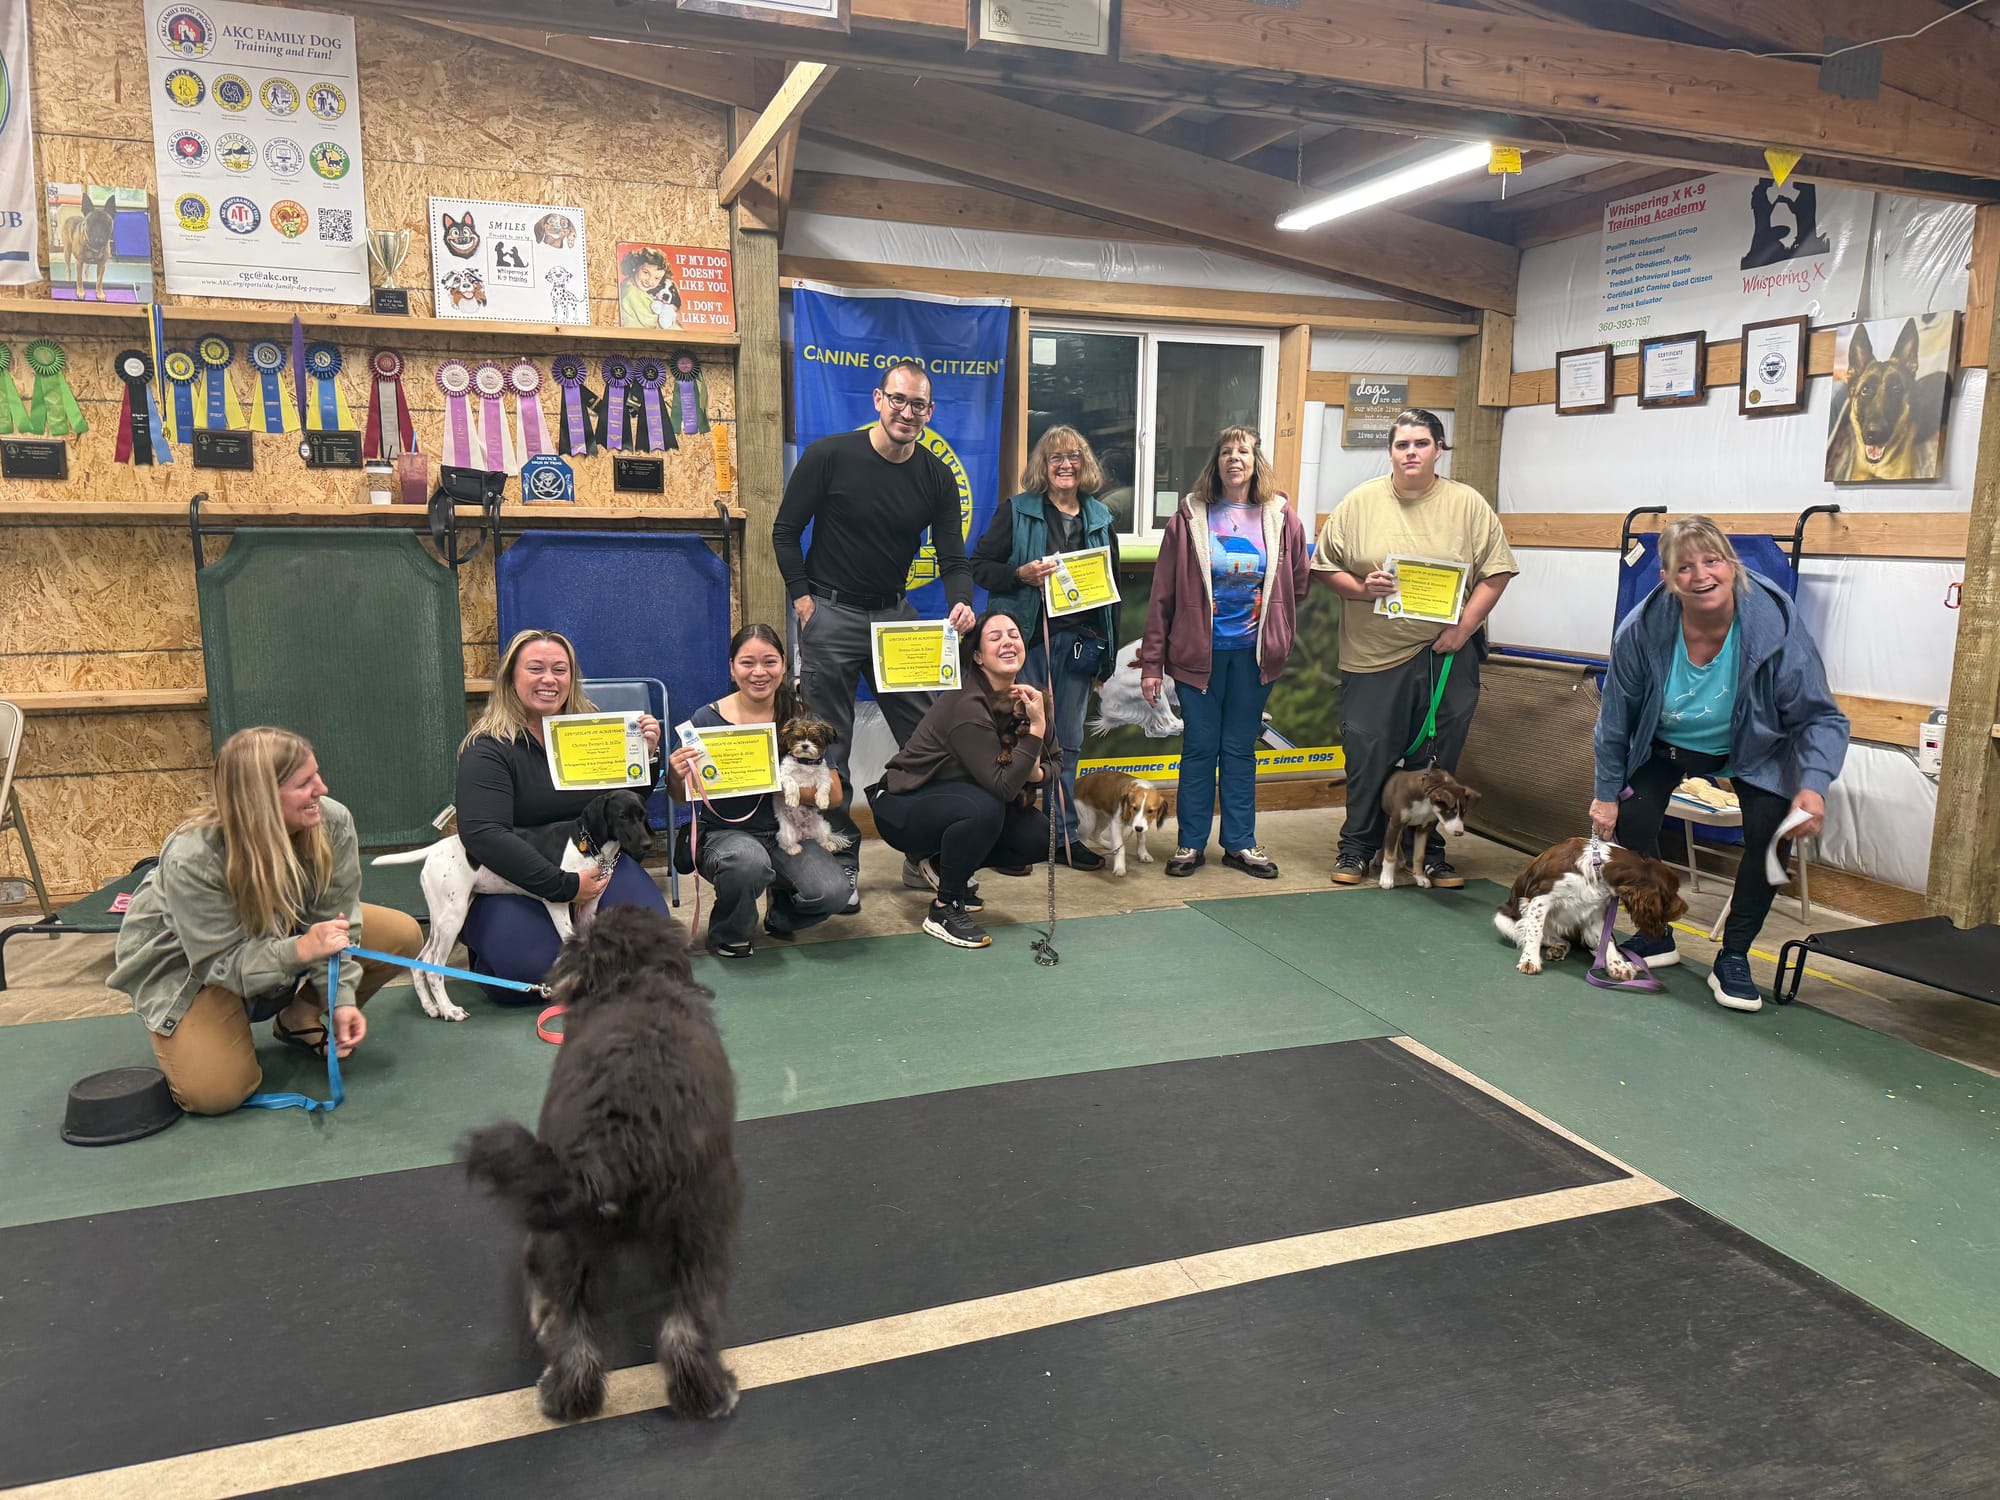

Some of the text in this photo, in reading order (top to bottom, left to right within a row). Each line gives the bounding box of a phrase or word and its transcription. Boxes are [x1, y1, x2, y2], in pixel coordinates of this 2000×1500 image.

[223, 24, 342, 49] AKC FAMILY DOG
[234, 39, 332, 60] Training and Fun!
[333, 145, 348, 160] DOG
[1609, 183, 1705, 218] Whispering X K-9
[231, 205, 249, 222] ATT
[1608, 200, 1706, 232] Training Academy
[488, 221, 527, 231] SMILES
[1628, 231, 1677, 247] Reinforcement
[1678, 226, 1698, 237] Group
[675, 254, 727, 267] IF MY DOG
[1605, 256, 1617, 264] and
[1673, 253, 1692, 263] Rally,
[239, 271, 299, 284] cgc@akc.org
[682, 267, 723, 279] DOESN'T
[1635, 271, 1670, 283] Behavioral
[1671, 267, 1691, 276] Issues
[1742, 262, 1826, 296] Whispering X
[679, 280, 705, 291] LIKE
[1607, 274, 1713, 300] Certified AKC Canine Good Citizen
[687, 300, 723, 312] I DON'T
[1606, 304, 1619, 312] and
[1620, 300, 1635, 310] Trick
[682, 313, 731, 325] LIKE YOU.
[1598, 315, 1651, 332] 360-393-7097
[803, 345, 870, 368] CANINE
[1657, 349, 1683, 359] CERTIFICATE
[1356, 378, 1390, 405] dogs
[930, 439, 970, 524] CITIZEN
[1273, 755, 1304, 765] since
[1308, 752, 1334, 762] 1995
